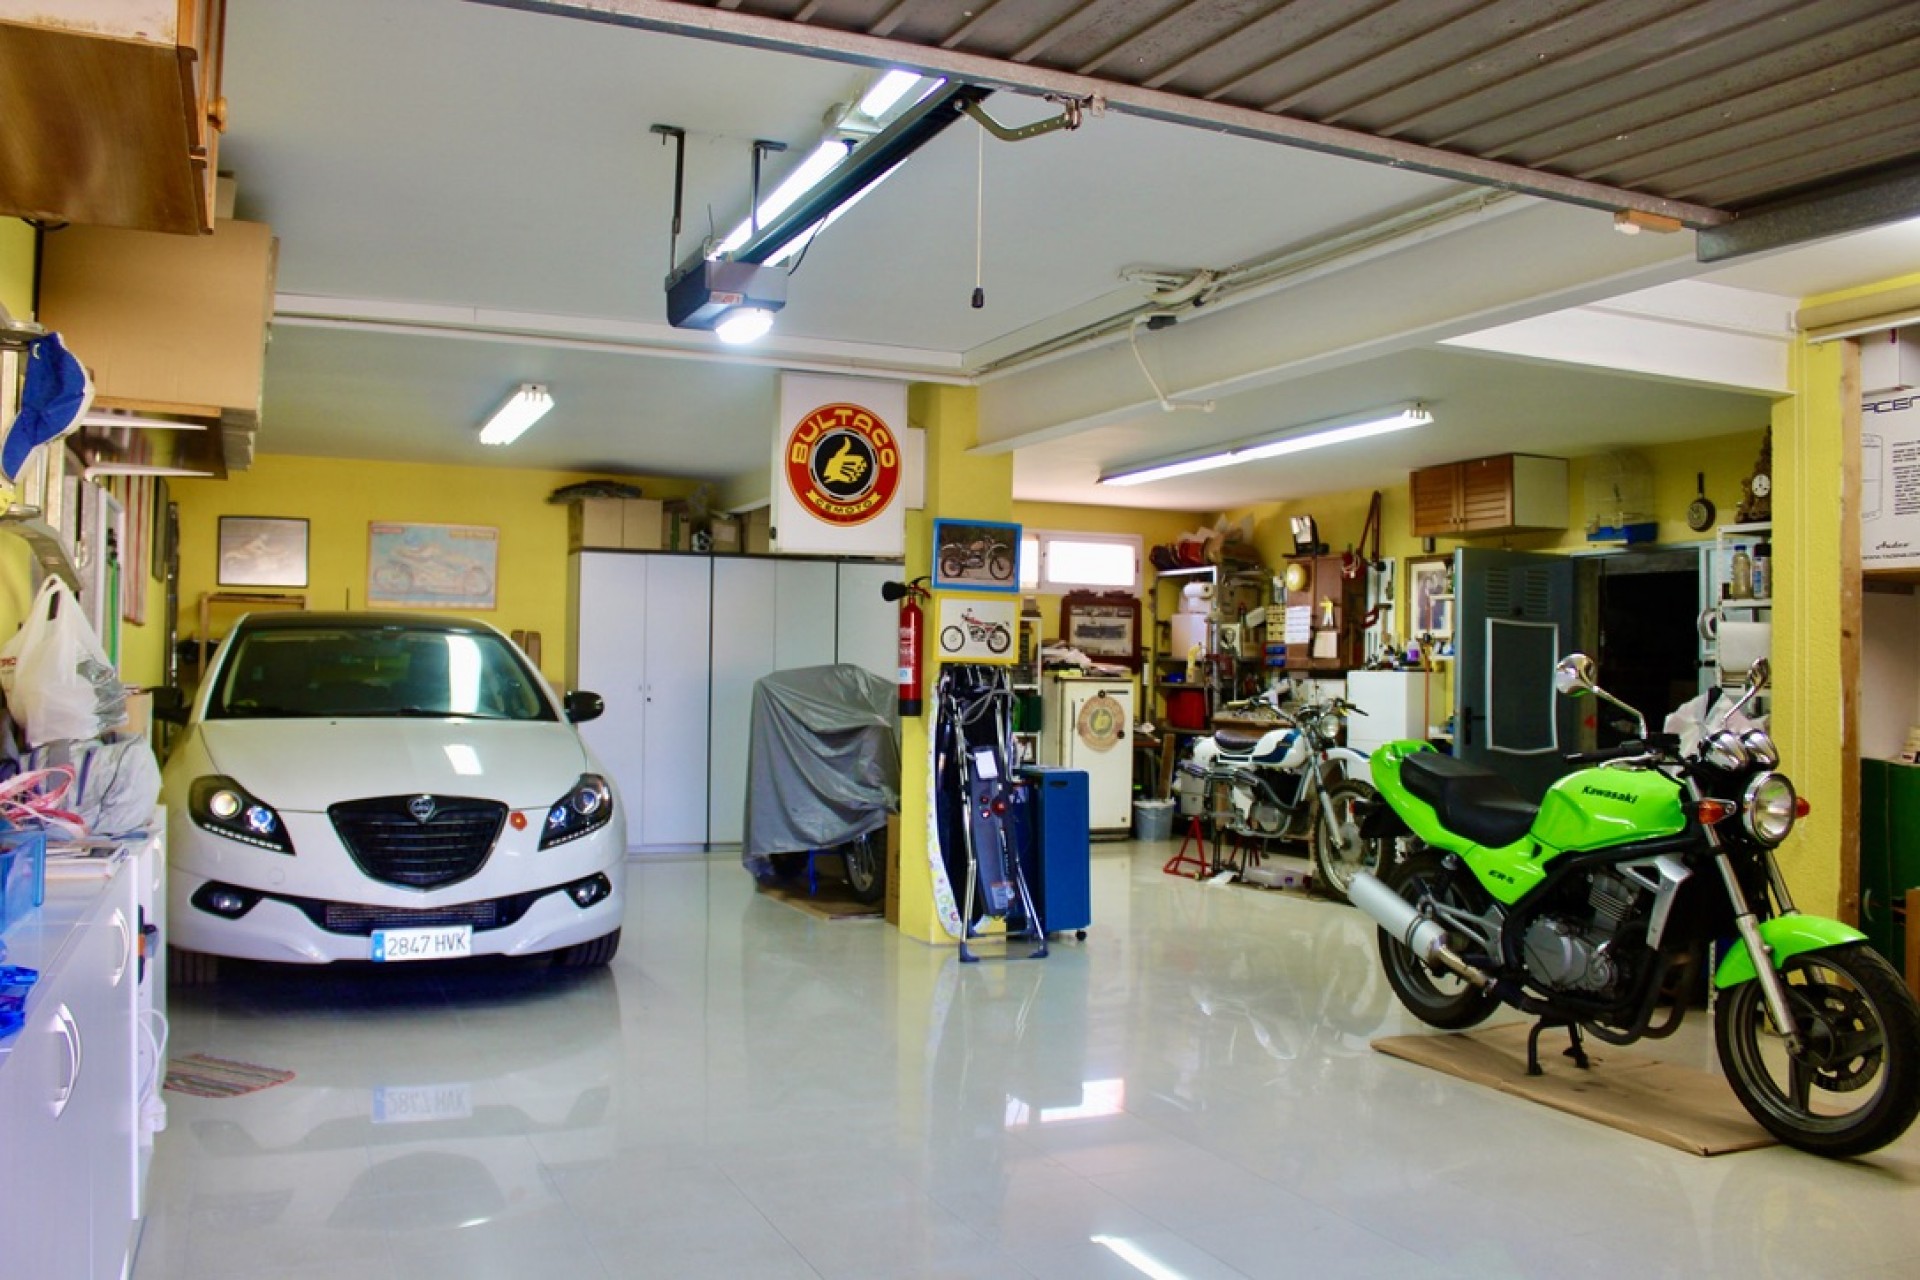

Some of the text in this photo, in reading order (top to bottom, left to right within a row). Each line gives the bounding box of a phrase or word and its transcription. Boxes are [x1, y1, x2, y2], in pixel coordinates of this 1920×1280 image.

[791, 409, 896, 468] BULTACO
[816, 498, 872, 514] CEMOTO
[1582, 785, 1638, 804] Kawasaki
[387, 932, 466, 956] 2847 HVK
